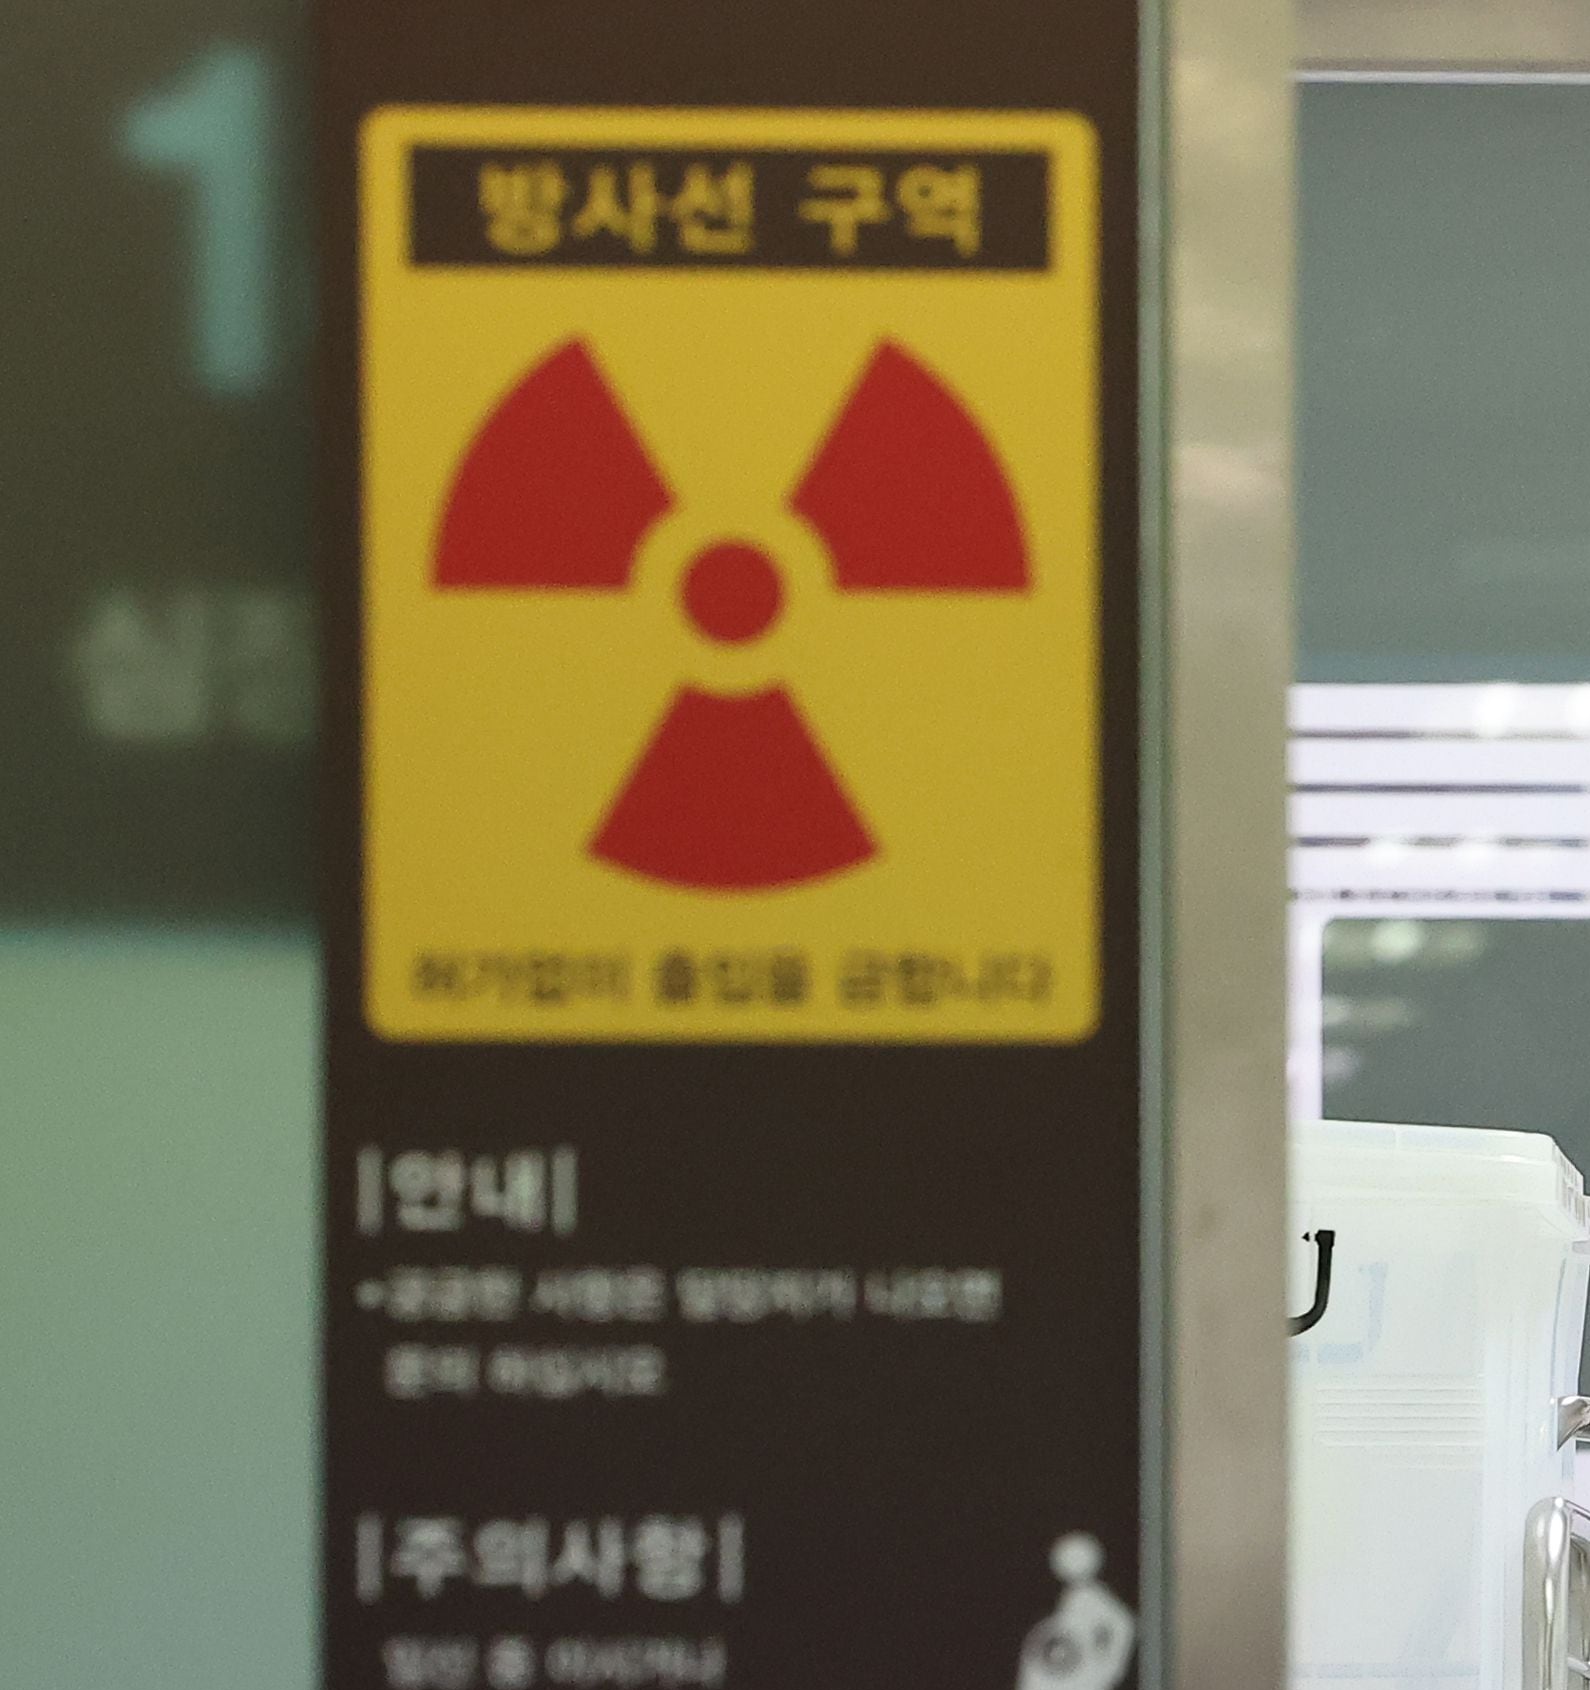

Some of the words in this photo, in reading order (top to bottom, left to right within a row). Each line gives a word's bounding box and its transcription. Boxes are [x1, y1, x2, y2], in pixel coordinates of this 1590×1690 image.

[122, 45, 276, 395] 1
[478, 162, 754, 254] 방사선
[803, 164, 981, 255] 구역
[390, 1149, 545, 1233] 안내
[393, 1517, 707, 1600] 주의사항
